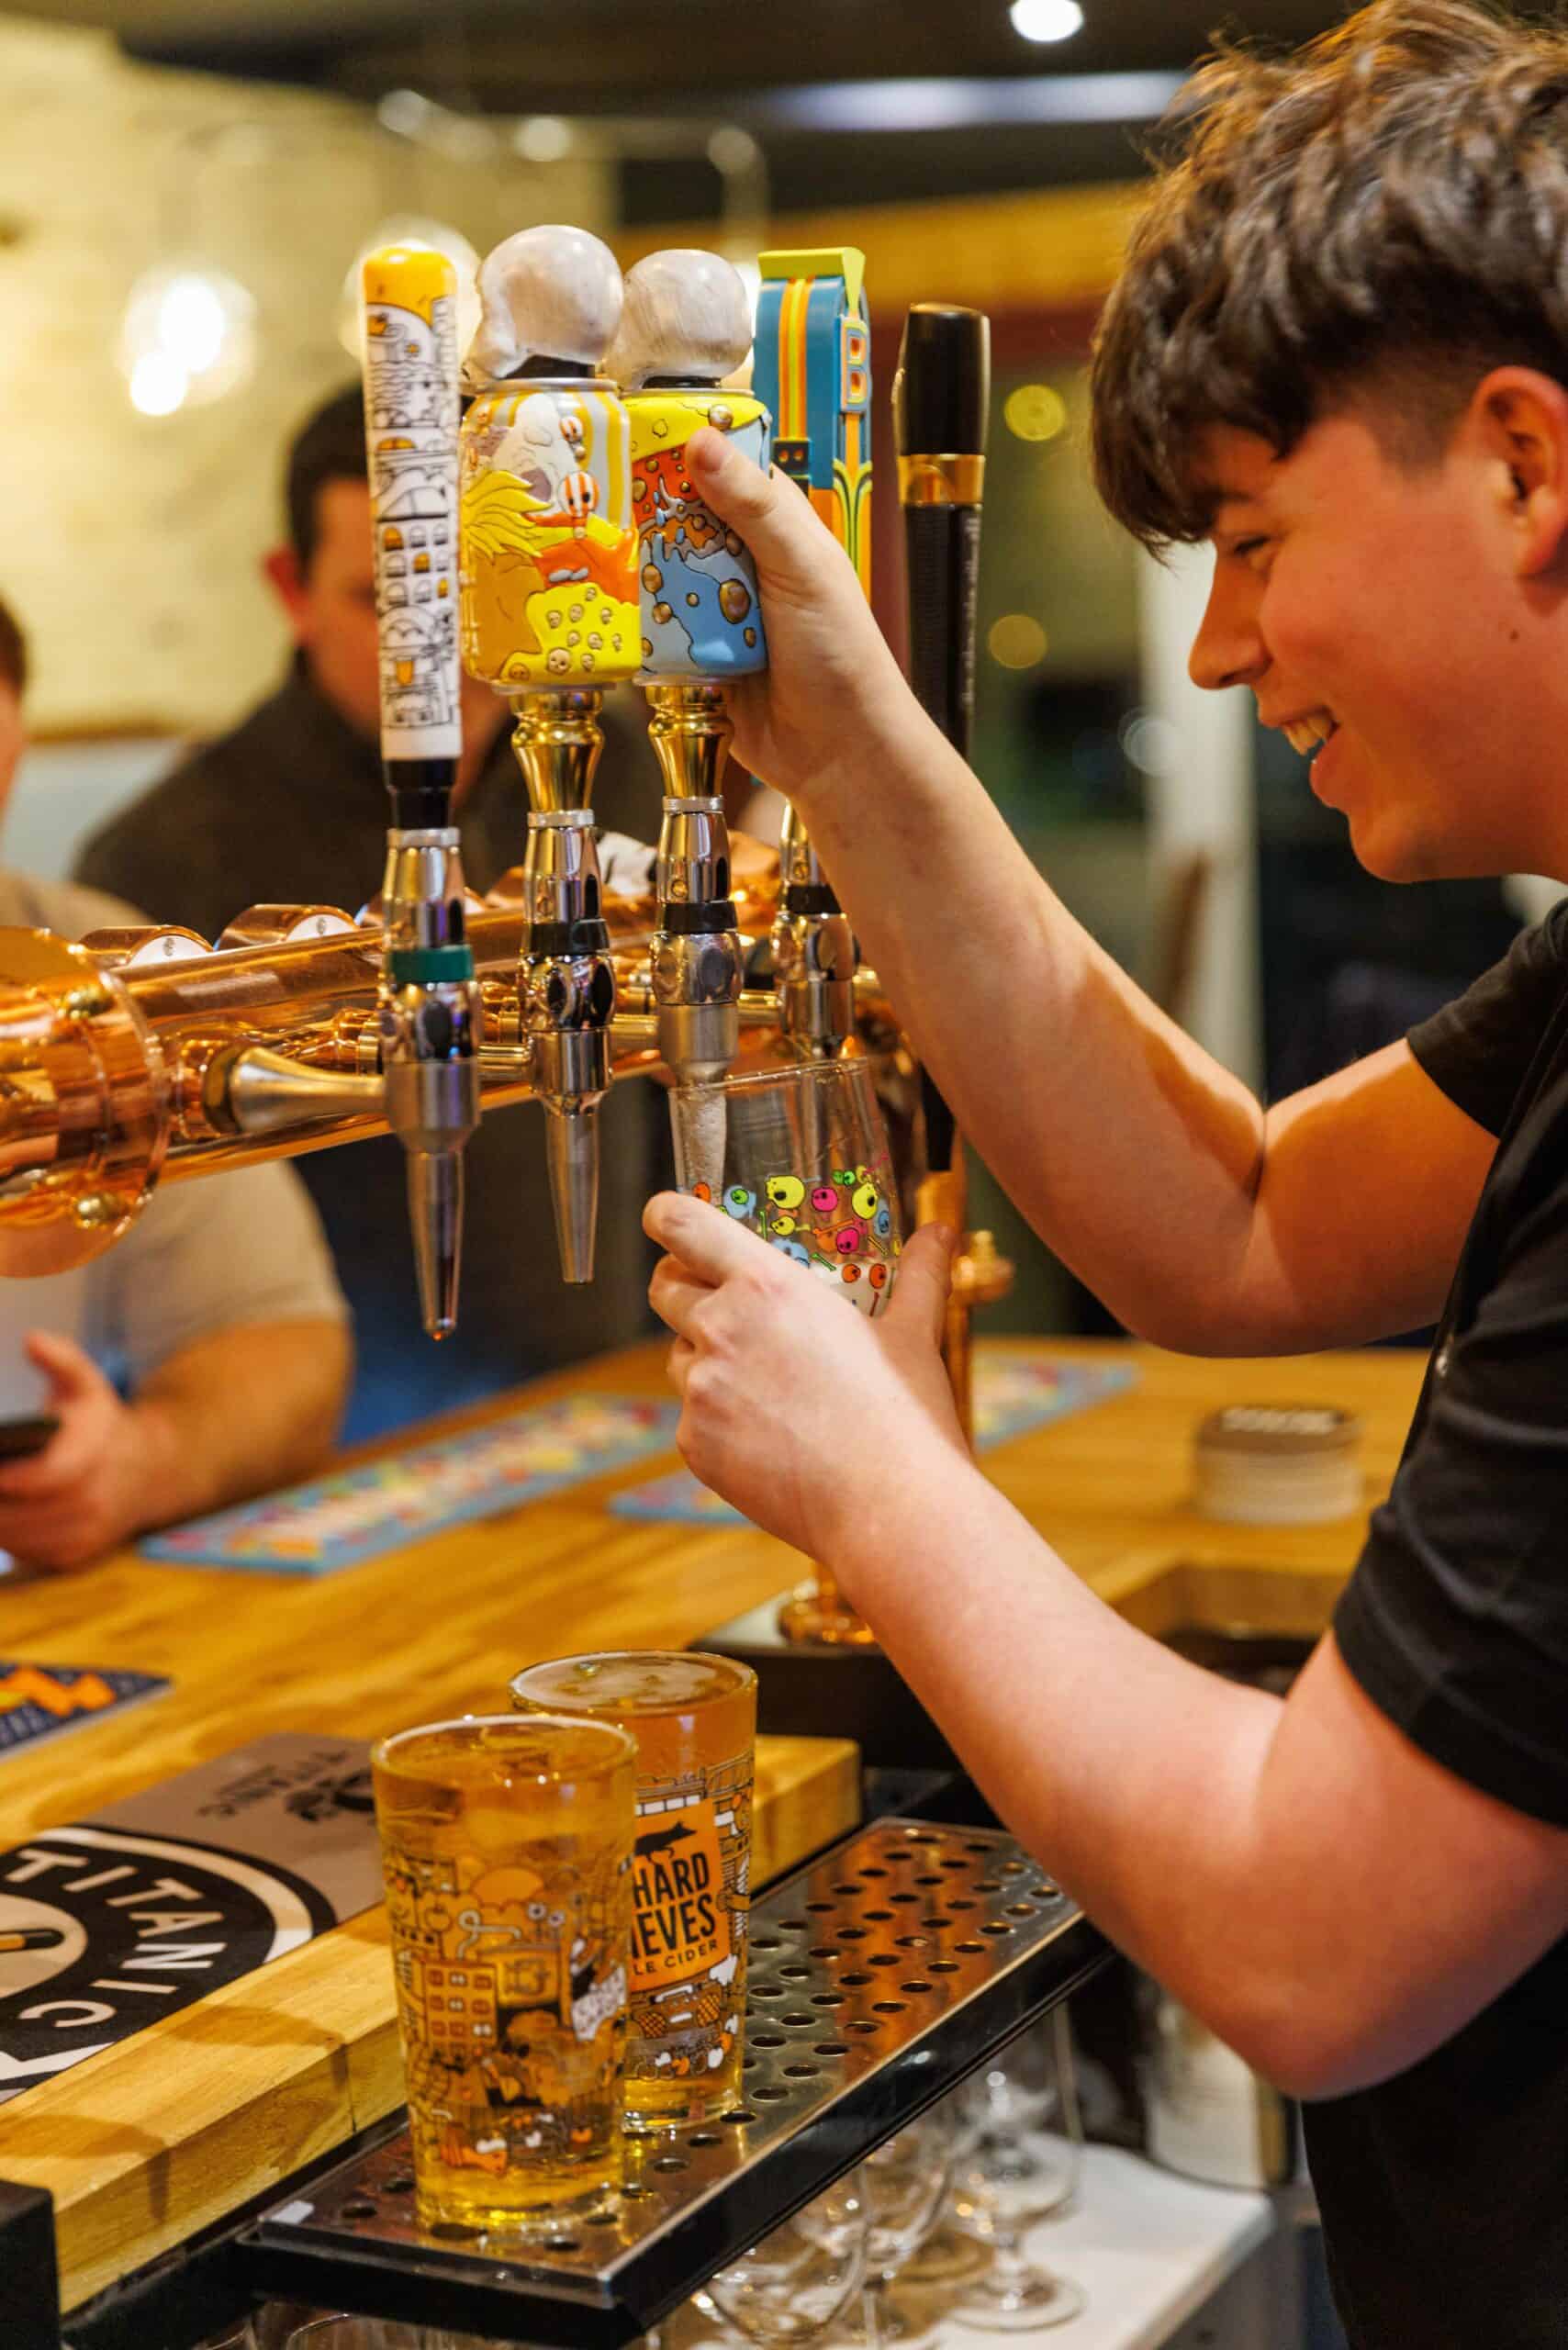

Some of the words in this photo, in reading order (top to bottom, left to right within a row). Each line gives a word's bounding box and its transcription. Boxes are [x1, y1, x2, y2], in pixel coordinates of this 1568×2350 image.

[633, 1852, 710, 1908] HARD
[4, 1848, 227, 2029] TITANIC
[632, 1893, 716, 1959] IEVES
[633, 1960, 657, 1976] LE
[664, 1938, 719, 1969] CIDER
